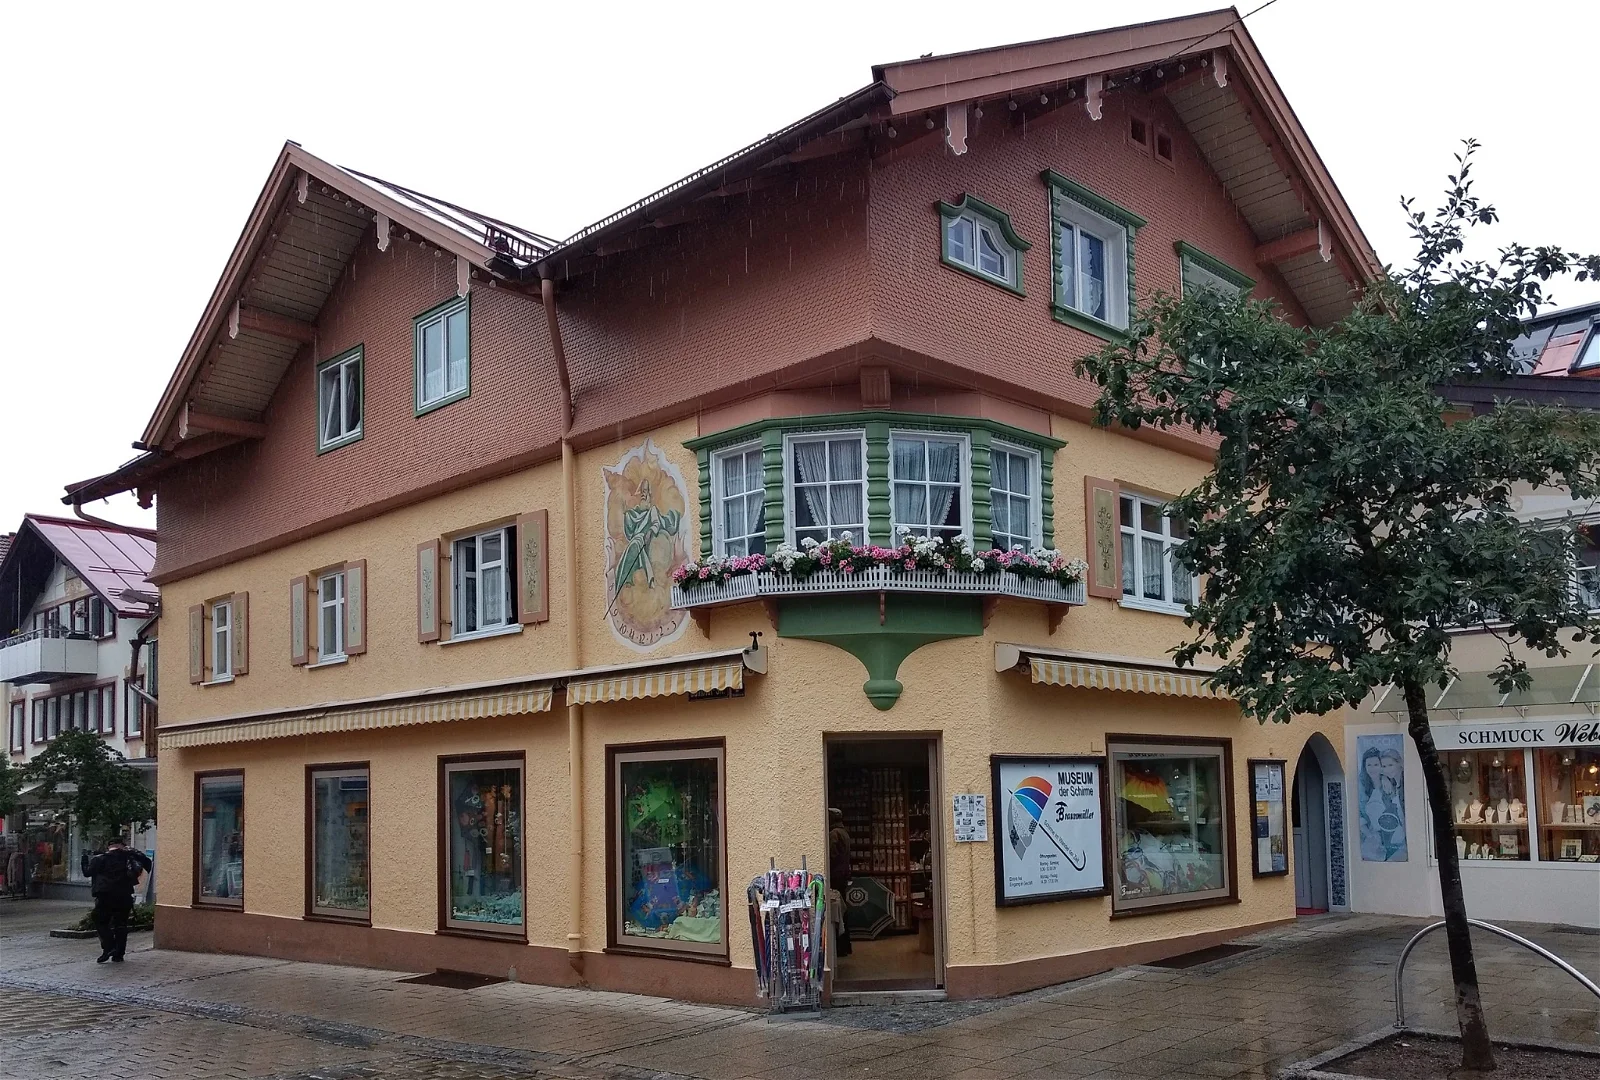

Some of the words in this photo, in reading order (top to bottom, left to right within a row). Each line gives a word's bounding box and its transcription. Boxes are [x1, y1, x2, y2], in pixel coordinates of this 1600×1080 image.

[619, 623, 627, 634] 10
[639, 633, 645, 644] 12
[1458, 729, 1545, 744] SCHMUCK
[1555, 722, 1600, 744] Web
[1058, 771, 1094, 785] MUSEUM
[1058, 786, 1069, 797] der
[1070, 785, 1094, 797] Schirme
